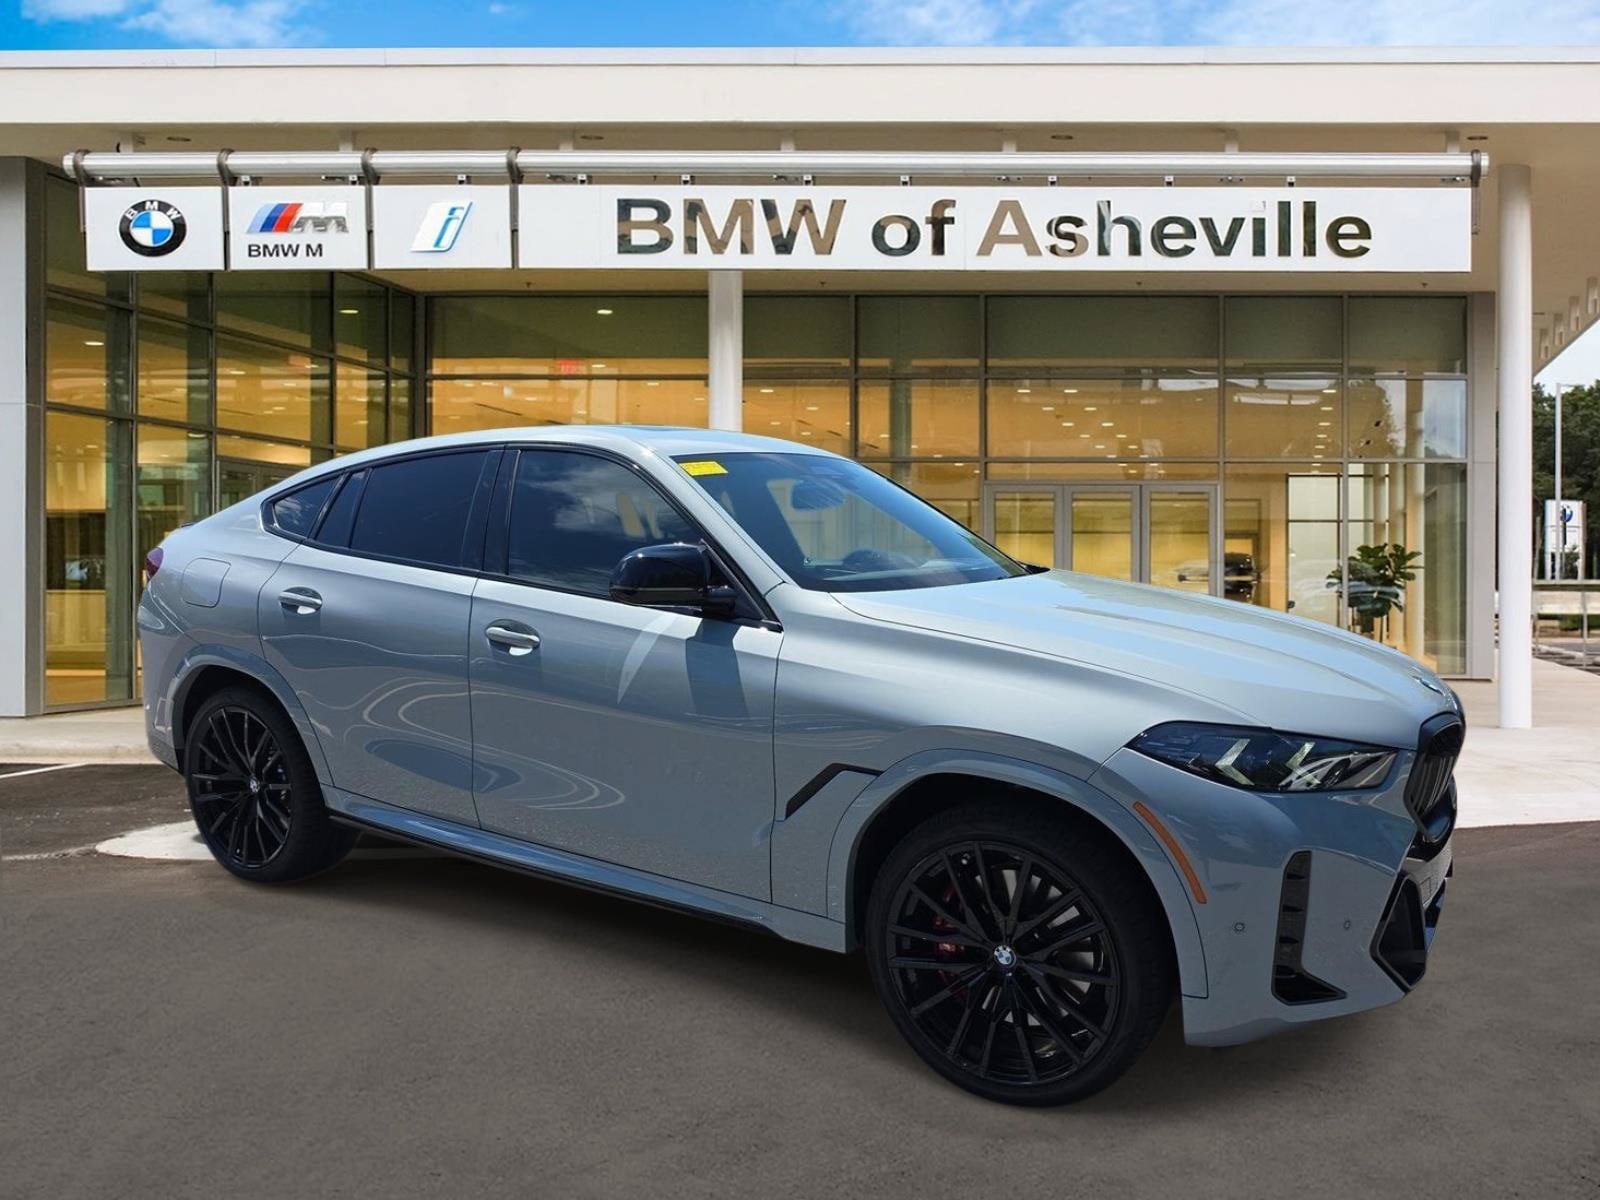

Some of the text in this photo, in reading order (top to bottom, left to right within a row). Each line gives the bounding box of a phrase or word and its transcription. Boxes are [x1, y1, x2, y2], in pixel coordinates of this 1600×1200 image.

[124, 200, 181, 220] BMW
[616, 198, 1373, 258] BMW of Asheville
[247, 243, 323, 258] BMW M
